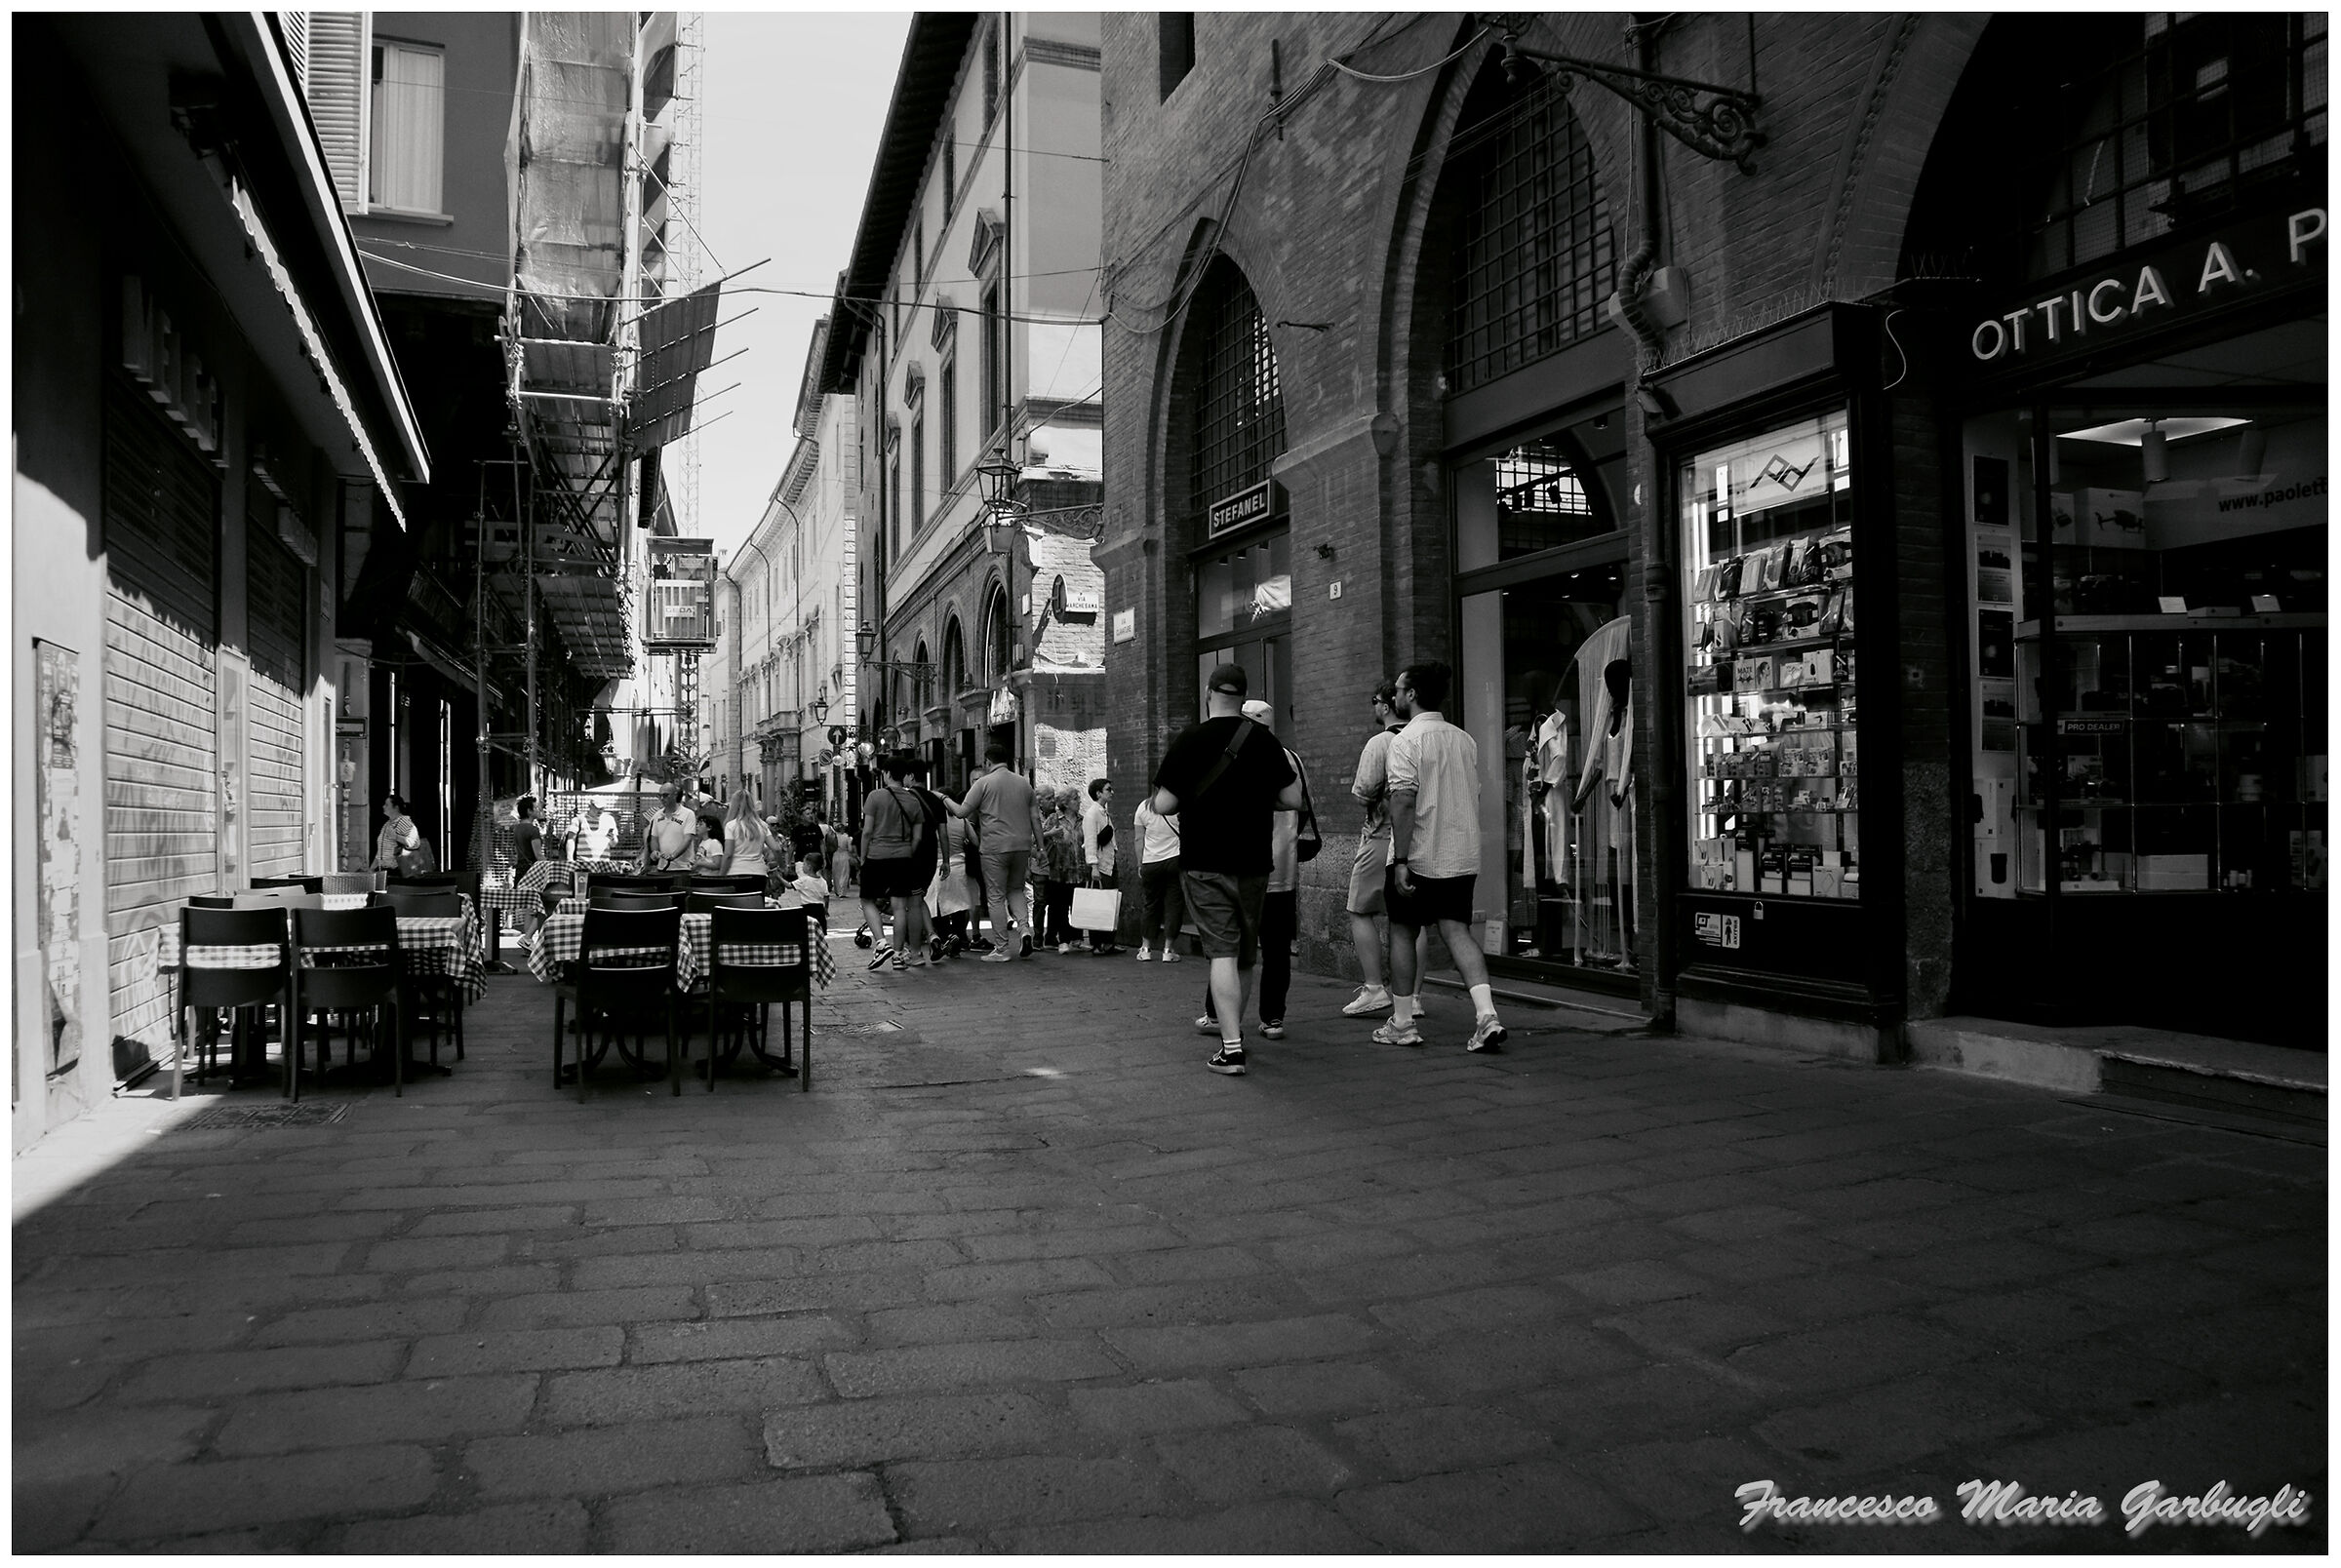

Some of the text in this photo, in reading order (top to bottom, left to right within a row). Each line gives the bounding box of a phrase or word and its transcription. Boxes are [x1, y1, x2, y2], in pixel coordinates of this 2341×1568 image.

[1972, 265, 2169, 360] OTTICA
[2198, 242, 2256, 293] A.
[1213, 492, 1265, 528] STEFANEL
